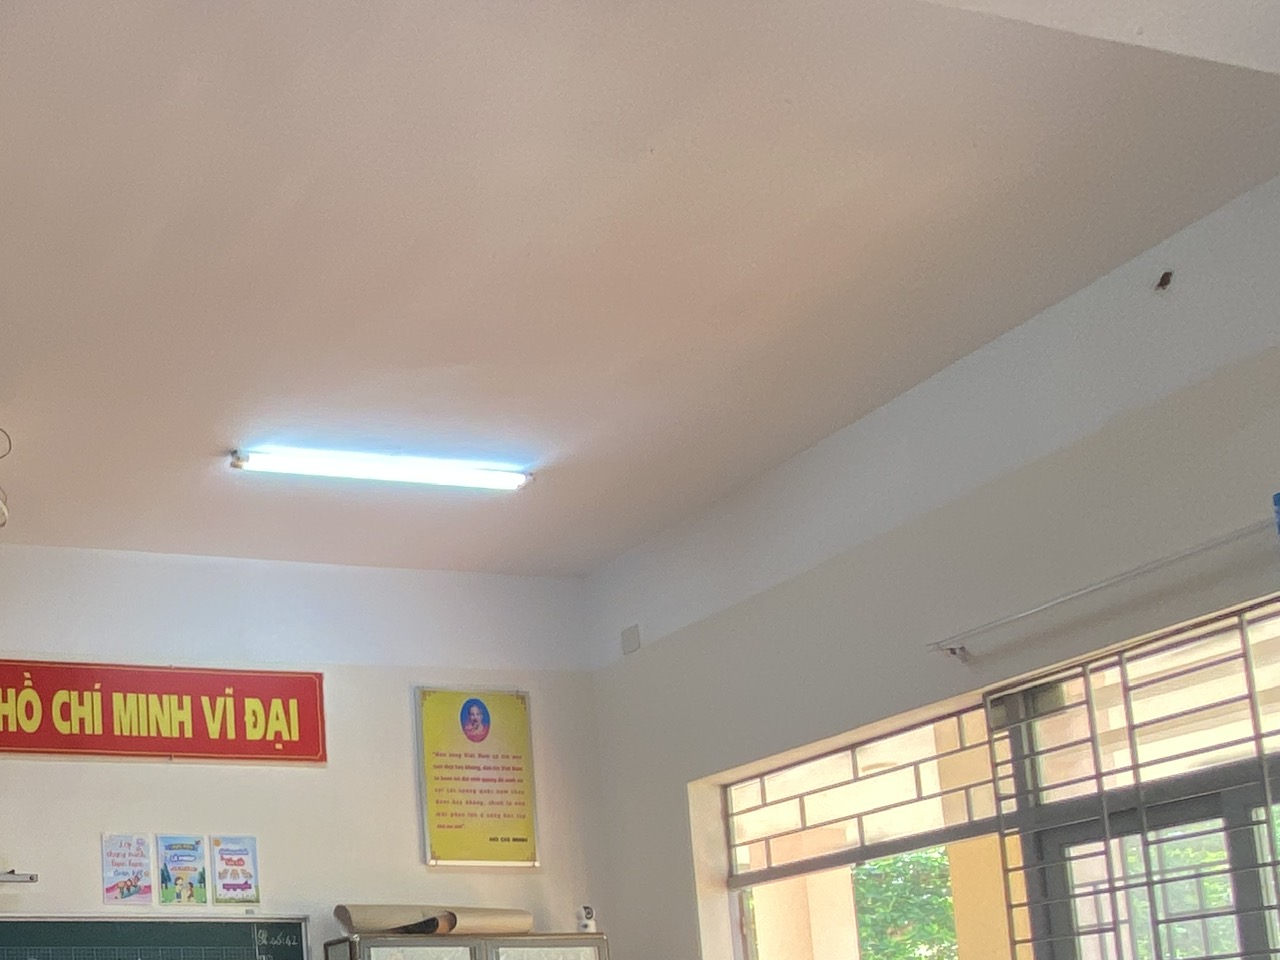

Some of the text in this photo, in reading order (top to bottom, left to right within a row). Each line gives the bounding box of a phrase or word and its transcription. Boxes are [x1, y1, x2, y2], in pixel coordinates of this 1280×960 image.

[51, 683, 103, 735] CHÍ
[112, 692, 193, 738] MINH
[201, 687, 236, 740] VĨ
[244, 697, 299, 749] ĐẠI
